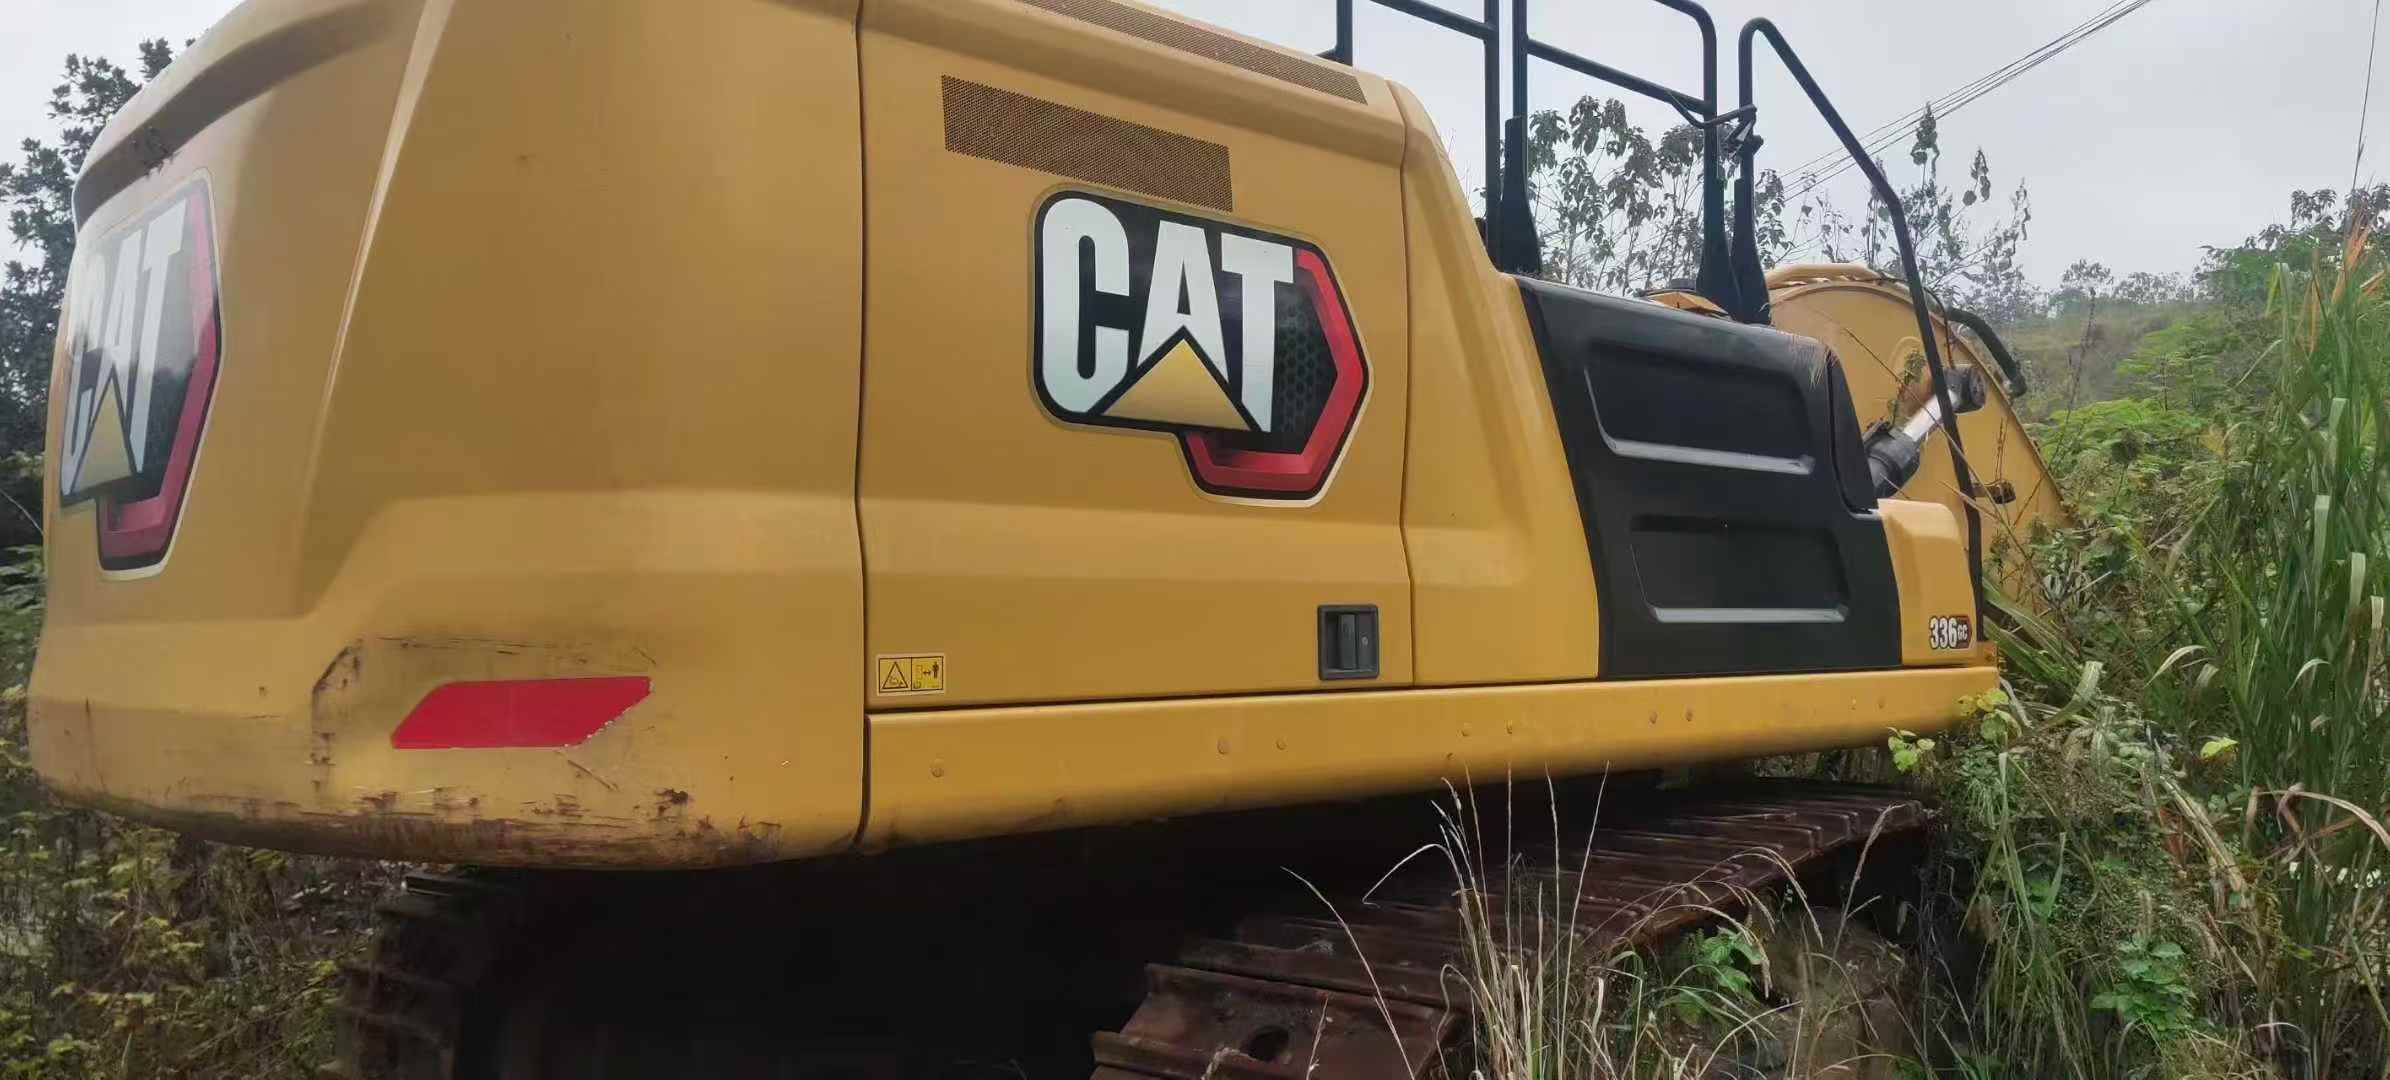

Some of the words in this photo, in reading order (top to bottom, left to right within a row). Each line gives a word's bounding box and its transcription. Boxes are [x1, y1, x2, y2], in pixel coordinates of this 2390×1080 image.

[60, 198, 188, 496] CAT
[1042, 198, 1294, 433] CAT
[1930, 617, 1957, 649] 336
[1957, 624, 1968, 640] GC
